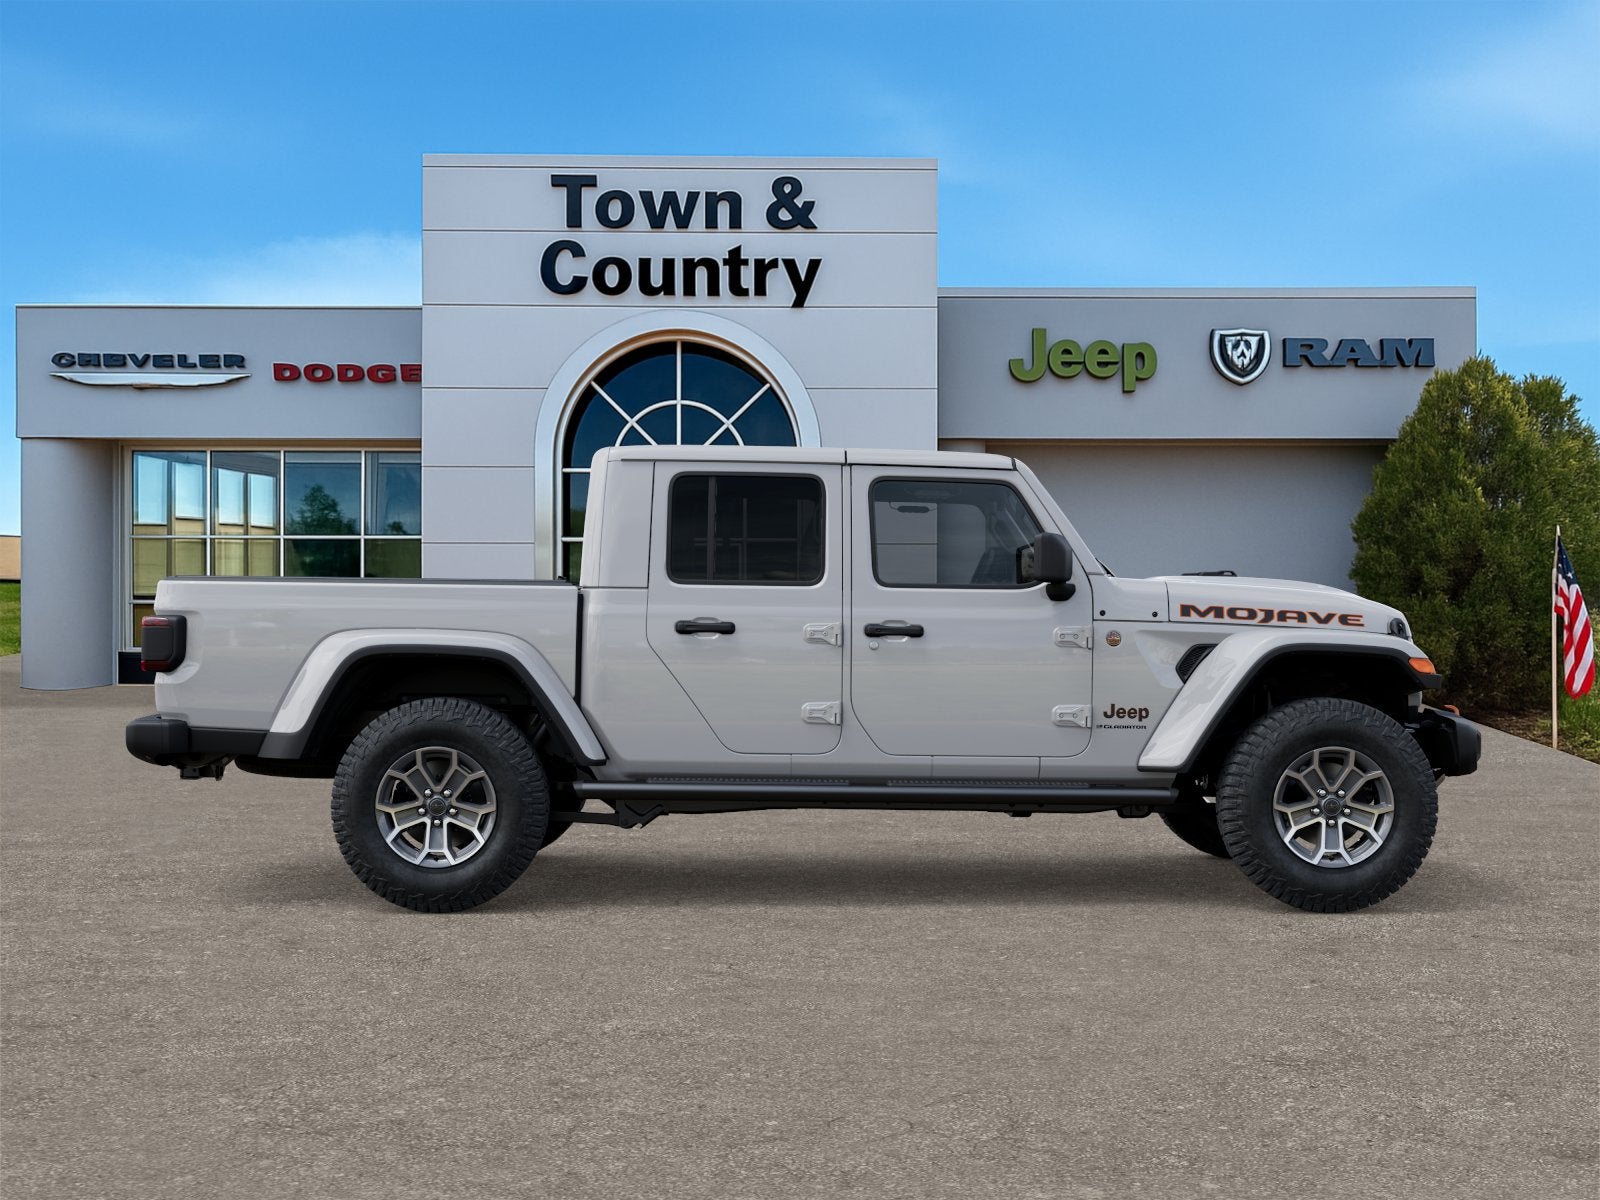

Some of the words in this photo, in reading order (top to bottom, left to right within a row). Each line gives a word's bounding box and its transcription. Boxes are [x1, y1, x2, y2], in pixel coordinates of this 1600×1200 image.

[551, 174, 743, 230] Town
[765, 175, 818, 230] &
[540, 239, 822, 308] Country
[1008, 327, 1158, 393] Jeep
[1282, 337, 1436, 368] RAM
[272, 362, 422, 384] DODGE
[1179, 603, 1365, 627] MOJAVE
[1103, 703, 1150, 722] Jeep
